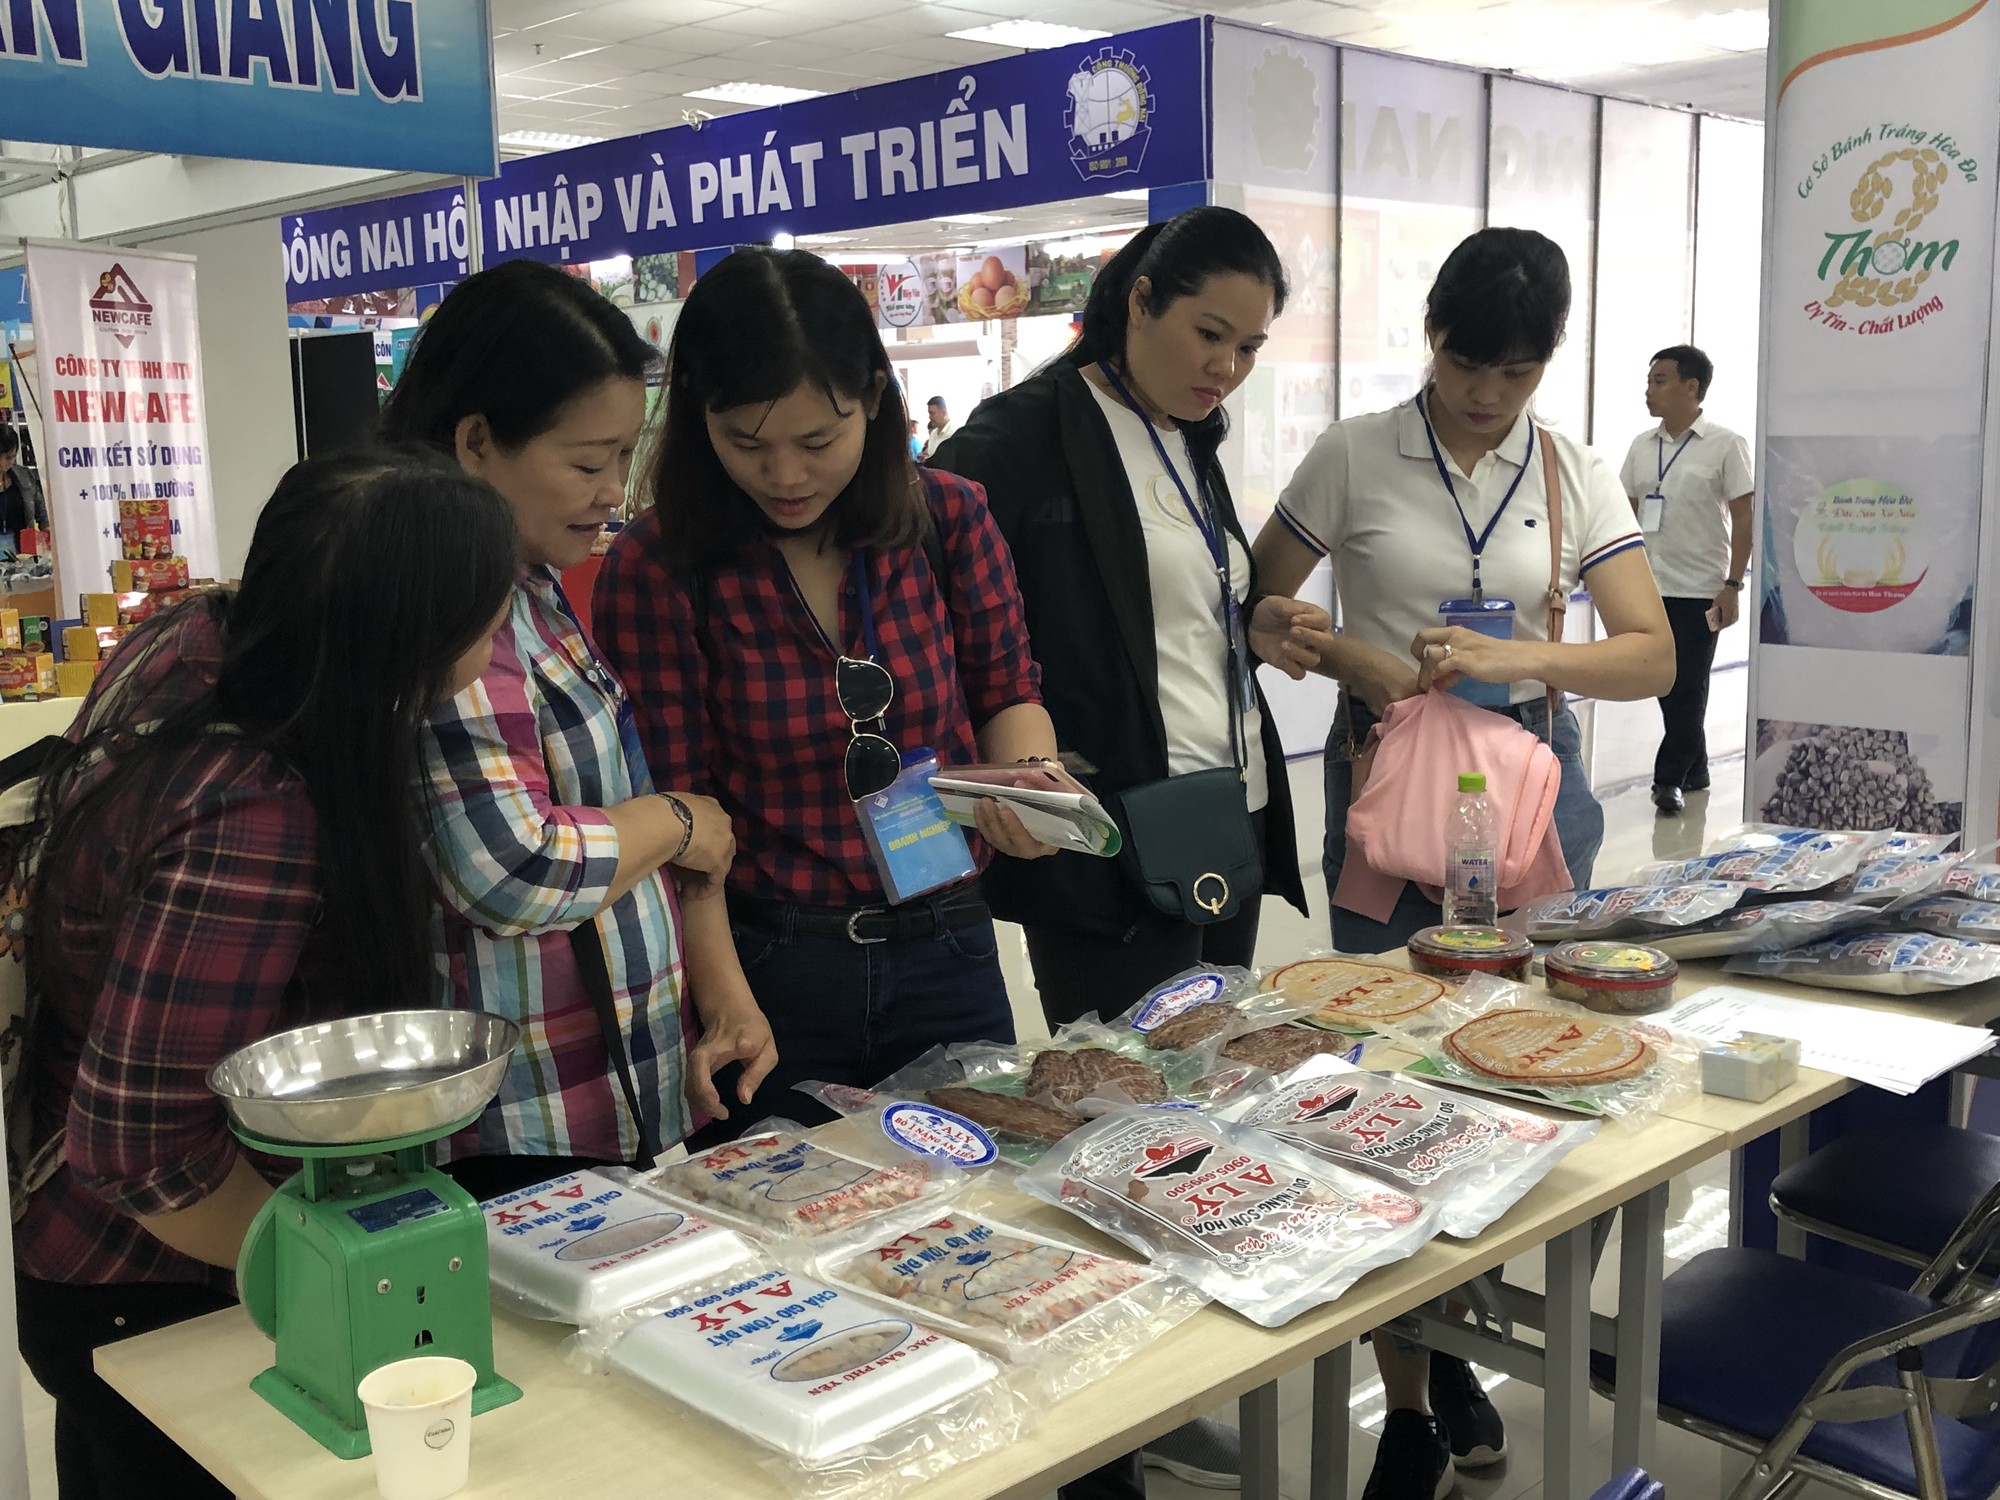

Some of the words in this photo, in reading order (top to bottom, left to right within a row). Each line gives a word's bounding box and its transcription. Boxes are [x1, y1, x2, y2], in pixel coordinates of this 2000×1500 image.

[1812, 154, 1829, 179] Sở
[1831, 127, 1872, 161] Bánh
[1879, 123, 1927, 145] Tráng
[1929, 132, 1961, 160] Hòa
[1957, 158, 1978, 183] Đa
[360, 216, 414, 273] NAI
[495, 175, 603, 260] NHẬP
[614, 153, 677, 233] VÀ
[689, 130, 823, 224] PHÁT
[841, 75, 1029, 201] TRIỂN
[1817, 229, 1960, 281] Thơm
[92, 310, 152, 326] NEWCAFE
[1804, 299, 1825, 320] Uy
[1858, 316, 1895, 335] Chất
[1898, 295, 1944, 330] Lượng
[55, 354, 97, 378] CÔNG
[101, 358, 121, 378] TY
[58, 447, 99, 468] CAM
[102, 440, 132, 467] KẾT
[137, 440, 157, 466] SỬ
[161, 446, 202, 469] DỤNG
[92, 484, 127, 501] 100%
[155, 478, 195, 499] ĐƯỜNG
[1556, 1024, 1582, 1043] A
[1389, 1094, 1425, 1112] A
[1440, 1102, 1459, 1115] BÒ
[942, 1126, 952, 1134] A
[1350, 1113, 1402, 1145] LÝ
[1397, 1129, 1424, 1149] SƠN
[1364, 1141, 1398, 1158] HÒA
[1165, 1155, 1252, 1198] 0905.699500
[1238, 1163, 1277, 1186] A
[551, 1183, 584, 1199] A
[591, 1190, 622, 1206] CHẢ
[1184, 1181, 1247, 1217] LÝ
[1260, 1193, 1294, 1214] NẮNG
[491, 1200, 552, 1226] LÝ
[532, 1211, 566, 1226] TÔM
[1232, 1205, 1262, 1229] SƠN
[502, 1222, 531, 1236] ĐẤT
[1192, 1218, 1227, 1235] HÒA
[1236, 1236, 1267, 1254] Yên
[760, 1269, 787, 1283] Tel:
[722, 1280, 760, 1298] 0905
[756, 1279, 794, 1298] A
[694, 1292, 723, 1308] 699
[802, 1290, 838, 1309] CHẢ
[664, 1304, 694, 1319] 500
[690, 1299, 758, 1332] LÝ
[775, 1303, 806, 1319] GIÒ
[737, 1315, 779, 1335] TÔM
[706, 1328, 743, 1347] ĐẤT
[907, 1334, 938, 1351] ĐẶC
[750, 1349, 782, 1366] 500gr
[876, 1350, 906, 1367] SẢN
[842, 1365, 876, 1382] PHÚ
[808, 1380, 842, 1397] YÊN
